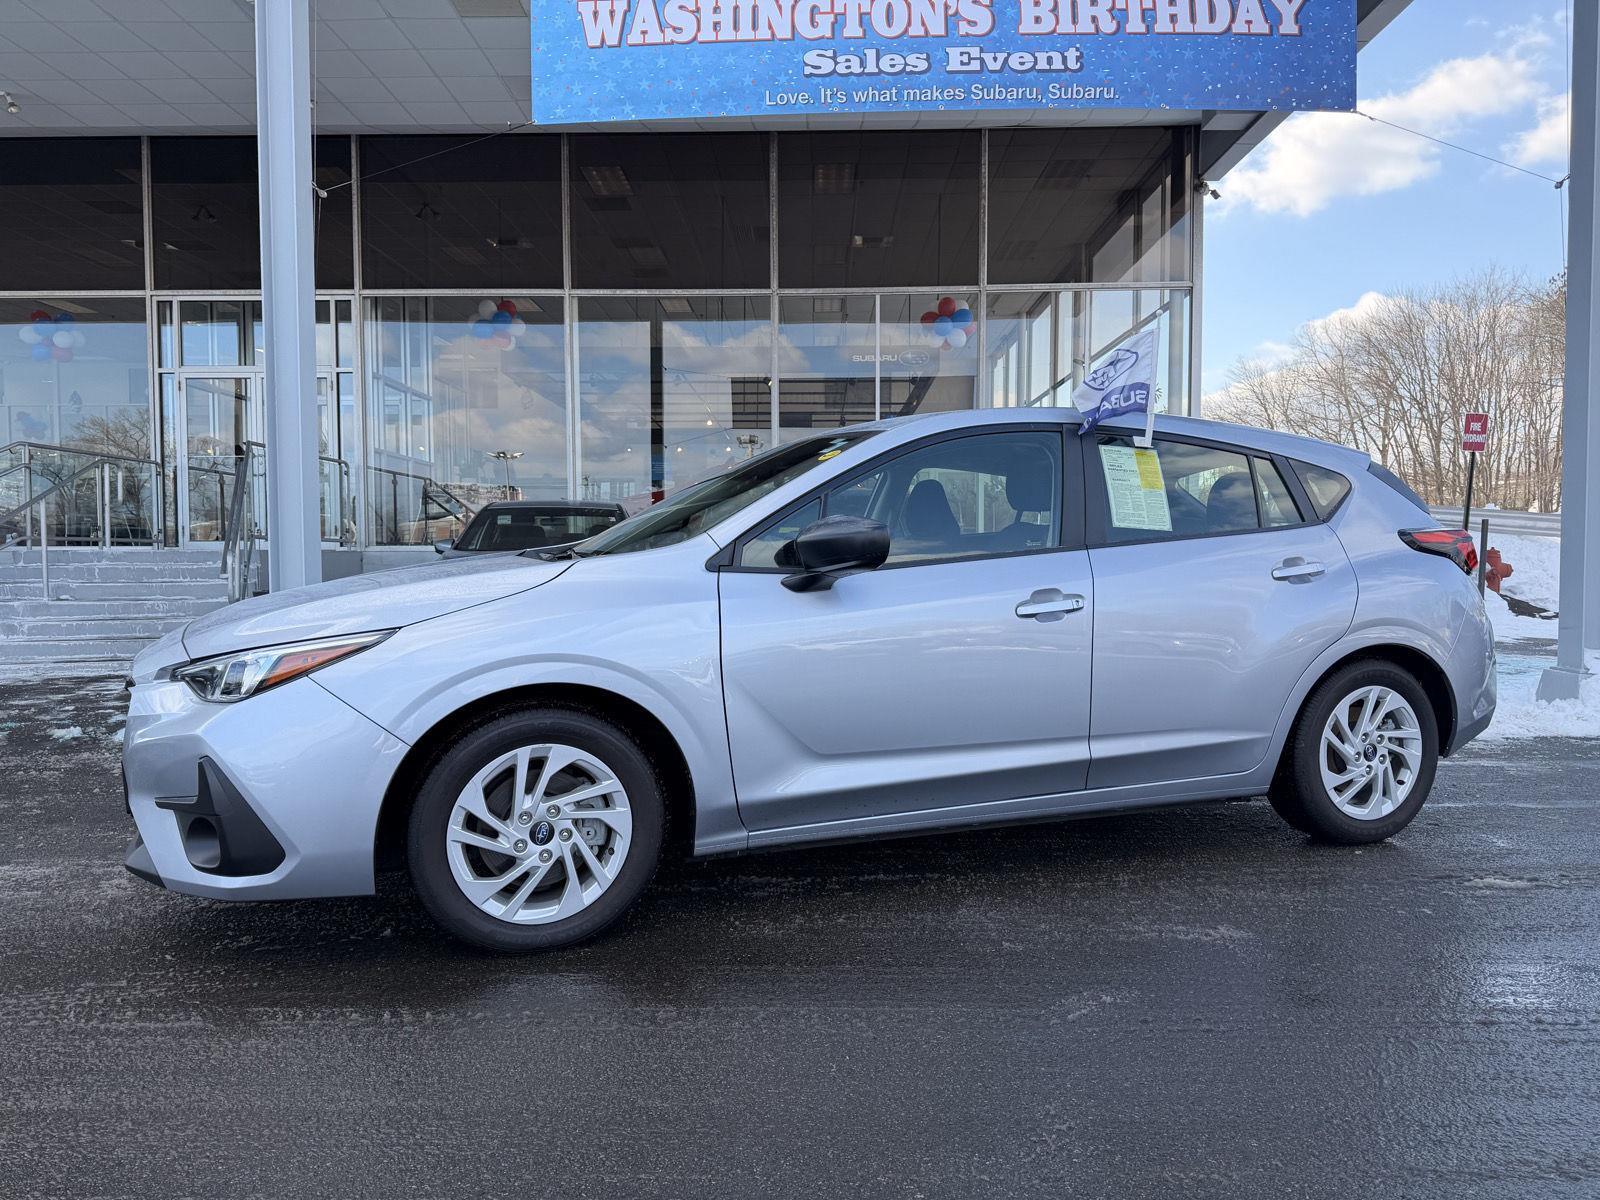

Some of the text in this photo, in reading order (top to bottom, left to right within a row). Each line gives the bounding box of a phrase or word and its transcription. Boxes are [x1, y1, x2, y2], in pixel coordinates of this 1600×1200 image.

[577, 0, 1304, 48] WASHINGTON'S BIRTHDAY
[803, 46, 1082, 76] Sales Event
[765, 83, 1120, 106] Love. It's what makes Subaru, Subaru.
[1469, 422, 1482, 432] FIRE
